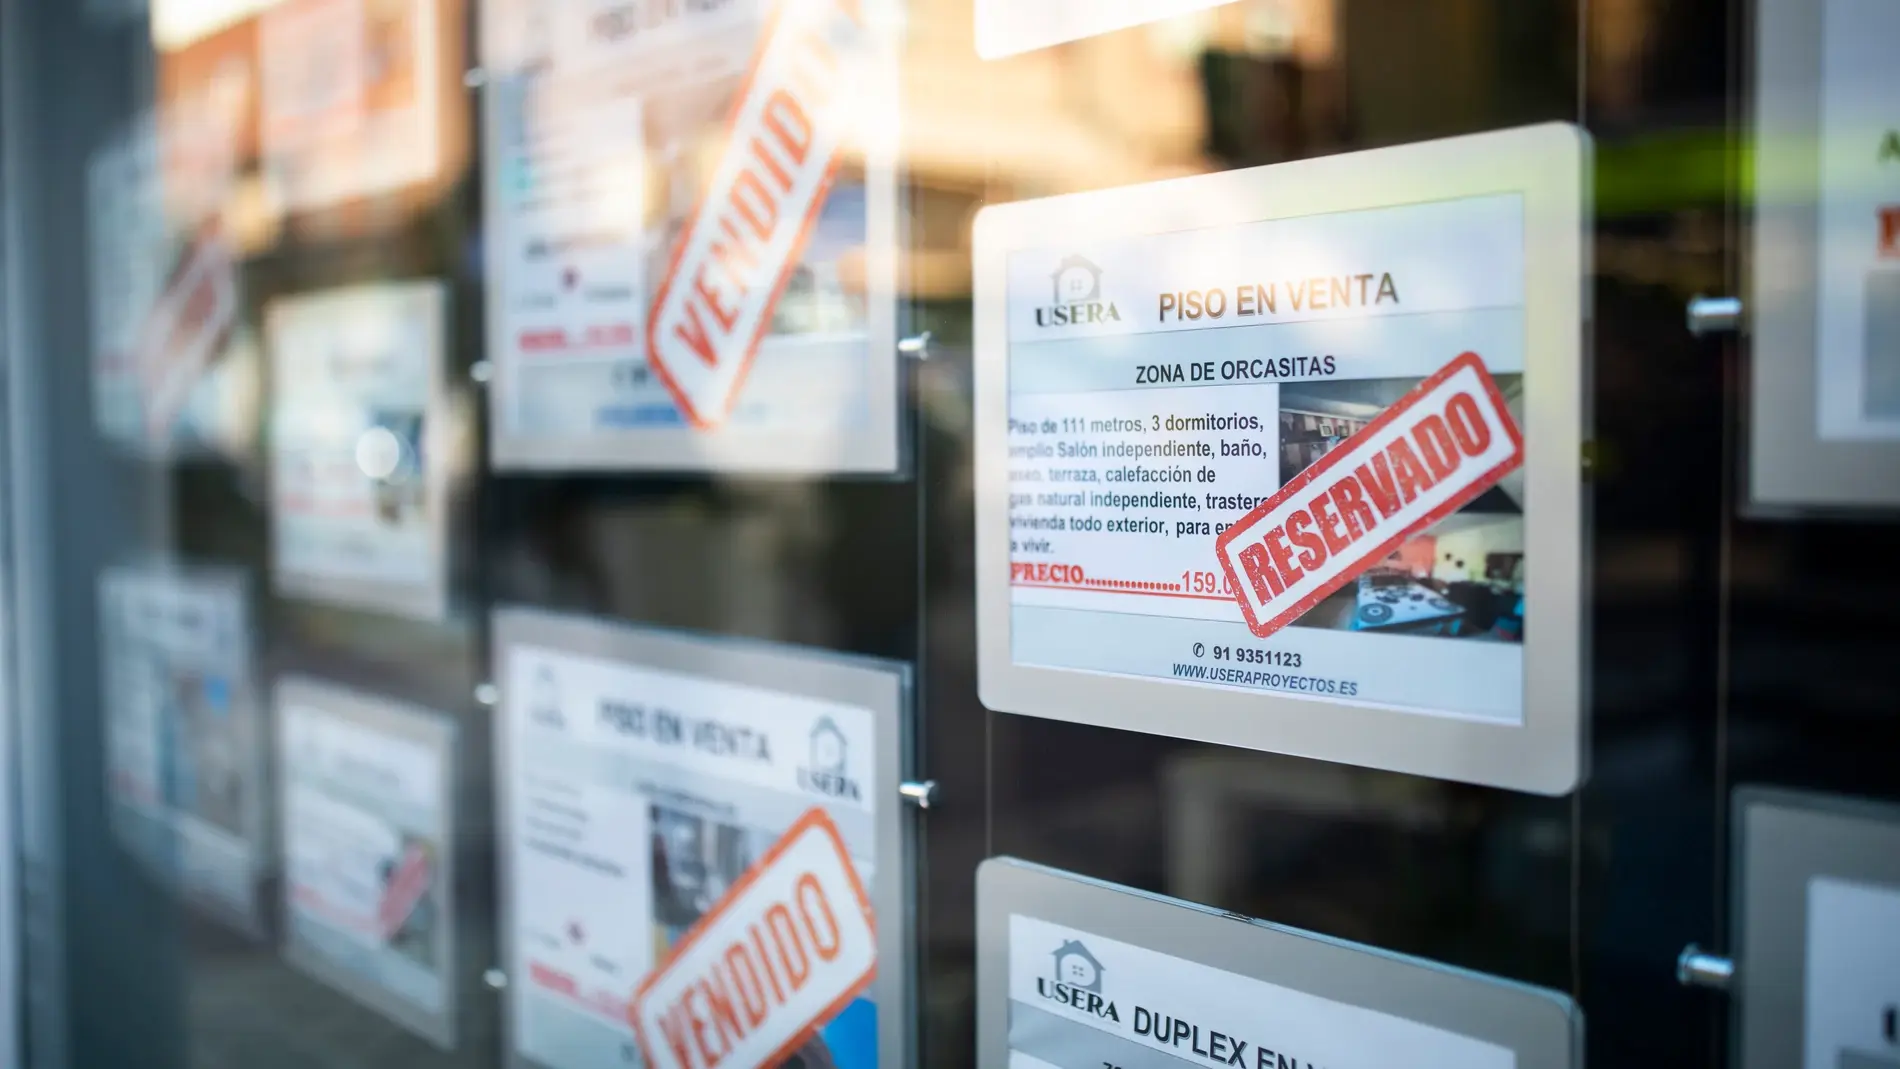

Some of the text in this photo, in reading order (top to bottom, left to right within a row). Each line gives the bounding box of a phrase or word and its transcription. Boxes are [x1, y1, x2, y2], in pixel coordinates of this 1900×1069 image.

[1159, 272, 1399, 323] PISO EN VENTA
[1036, 302, 1121, 327] USERA
[1136, 355, 1336, 384] ZONA DE ORCASITAS
[1041, 417, 1058, 434] de
[1063, 417, 1085, 433] 111
[1090, 417, 1146, 434] metros,
[1152, 414, 1160, 431] 3
[1165, 412, 1264, 432] dormitorios,
[1057, 441, 1098, 457] Salón
[1102, 440, 1215, 460] independiente,
[1221, 438, 1267, 459] baño,
[1049, 468, 1101, 484] terraza,
[1106, 465, 1191, 482] calefacción
[1197, 465, 1216, 482] de
[1037, 491, 1085, 507] natural
[1090, 491, 1201, 511] independiente,
[1238, 391, 1491, 607] RESERVADO
[1070, 516, 1102, 532] todo
[1107, 517, 1168, 536] exterior,
[1176, 520, 1210, 538] para
[1213, 645, 1302, 668] 91 9351123
[1173, 663, 1358, 696] WWW.USERAPROYECTOS.ES
[657, 872, 841, 1069] VENDIDO
[1036, 976, 1121, 1023] USERA
[1133, 1005, 1248, 1069] DUPLEX
